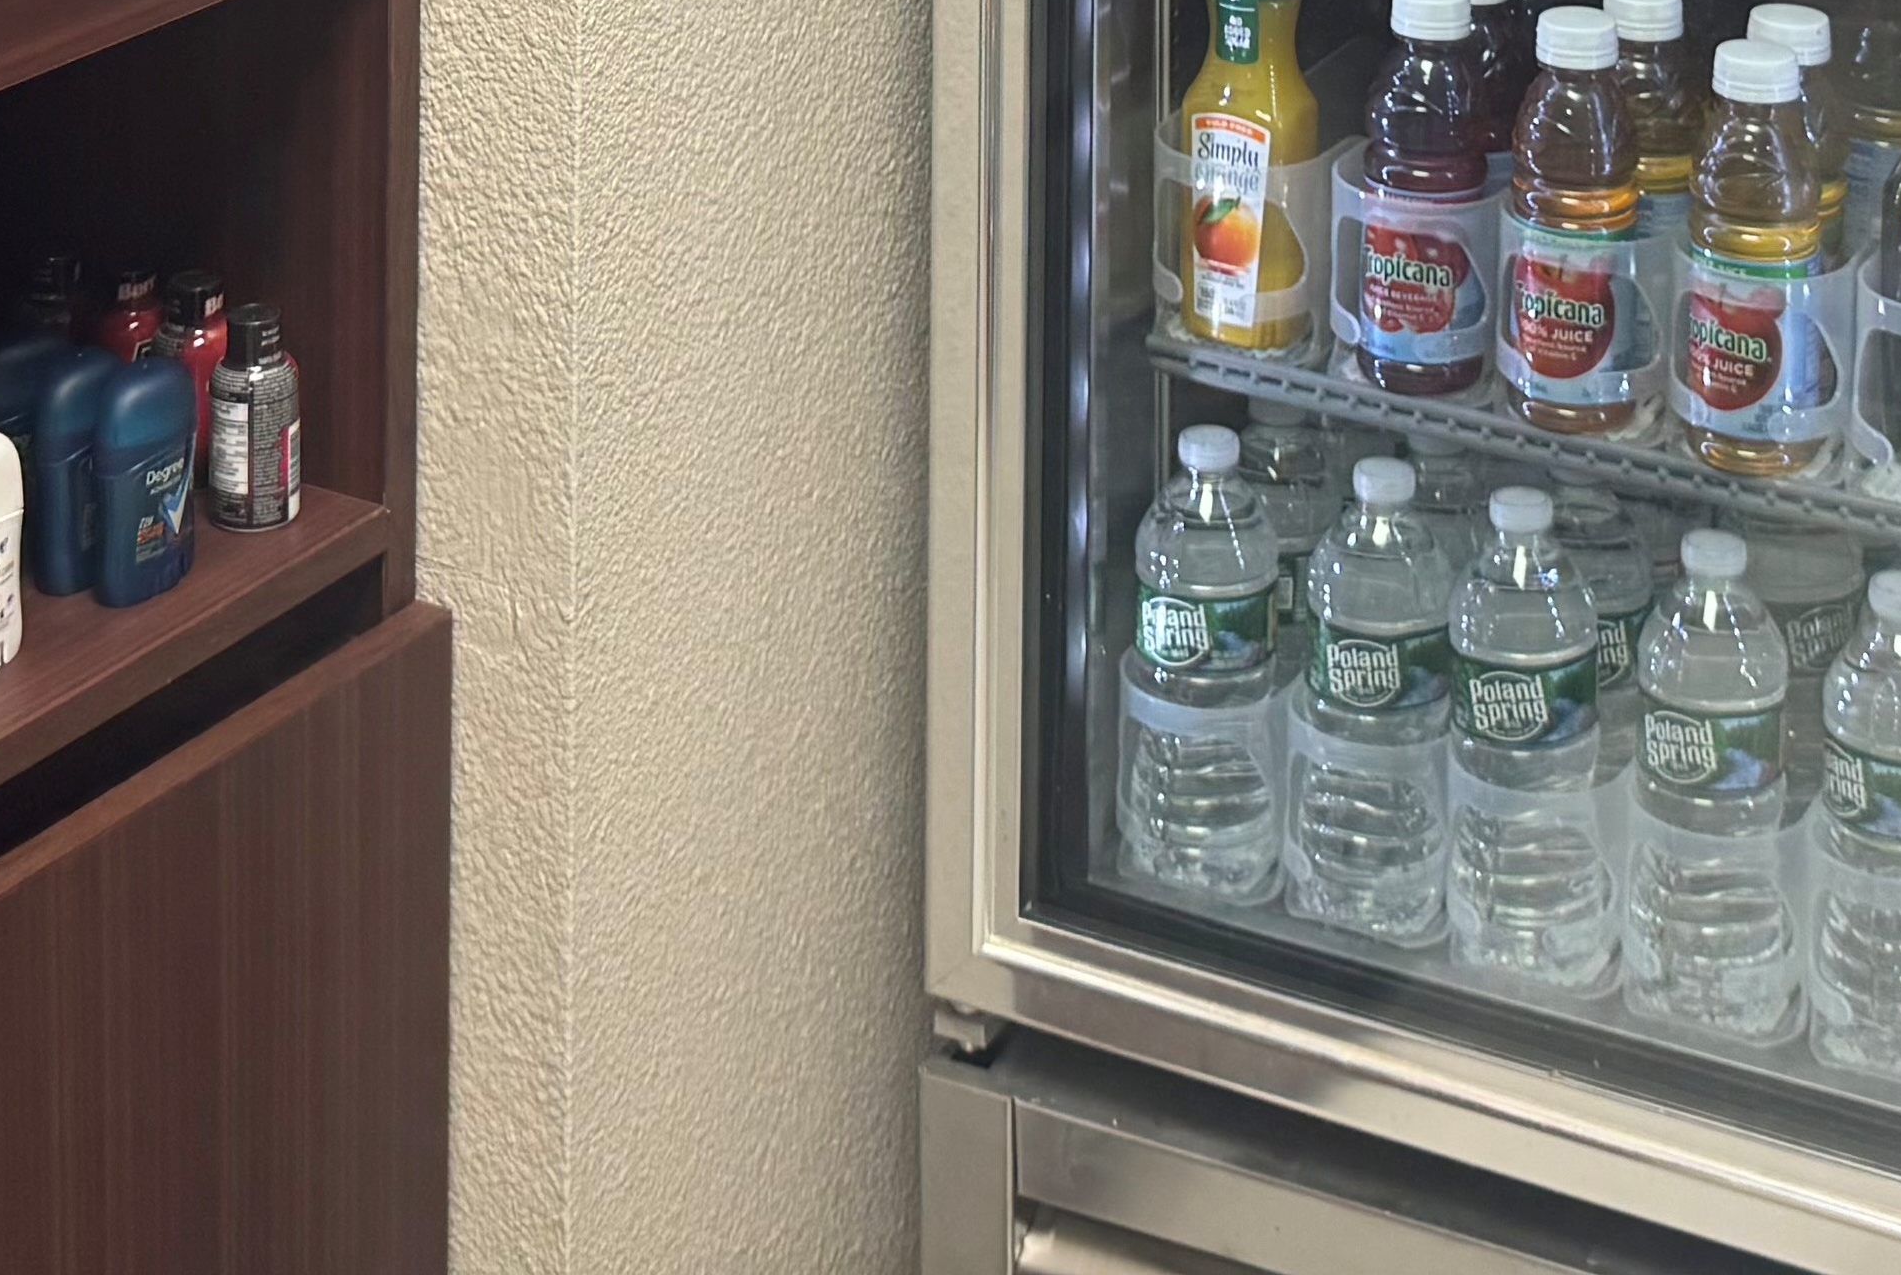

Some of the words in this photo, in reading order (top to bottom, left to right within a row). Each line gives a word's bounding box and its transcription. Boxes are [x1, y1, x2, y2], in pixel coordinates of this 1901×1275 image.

[1197, 131, 1259, 170] Simply
[1470, 677, 1543, 707] Poland
[1474, 698, 1548, 730] Spring
